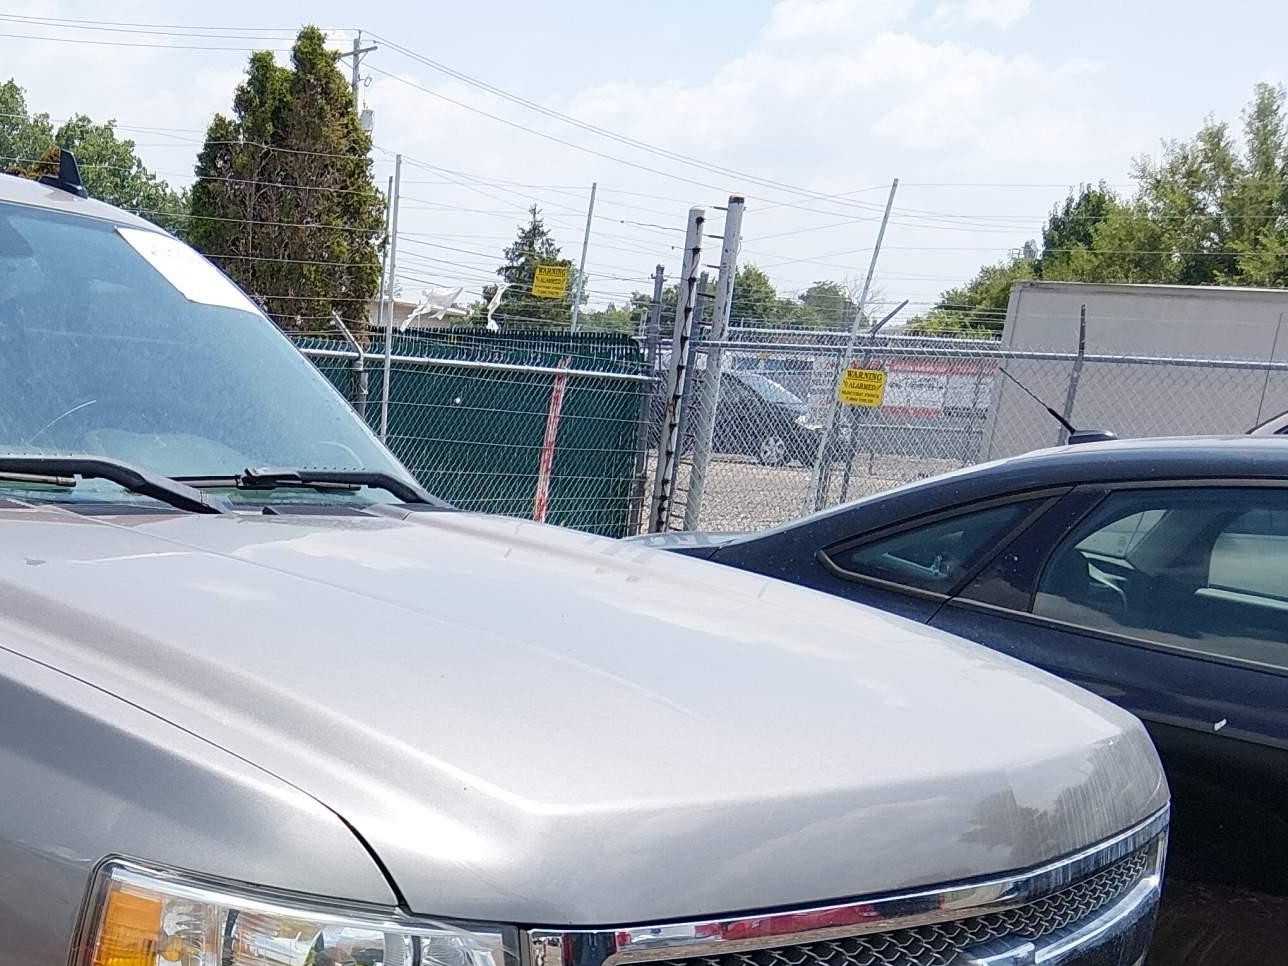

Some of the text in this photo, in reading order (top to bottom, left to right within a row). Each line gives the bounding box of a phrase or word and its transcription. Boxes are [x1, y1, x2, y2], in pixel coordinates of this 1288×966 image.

[538, 267, 565, 277] WARNING
[847, 370, 882, 381] WARNING
[850, 382, 876, 391] ALARMED
